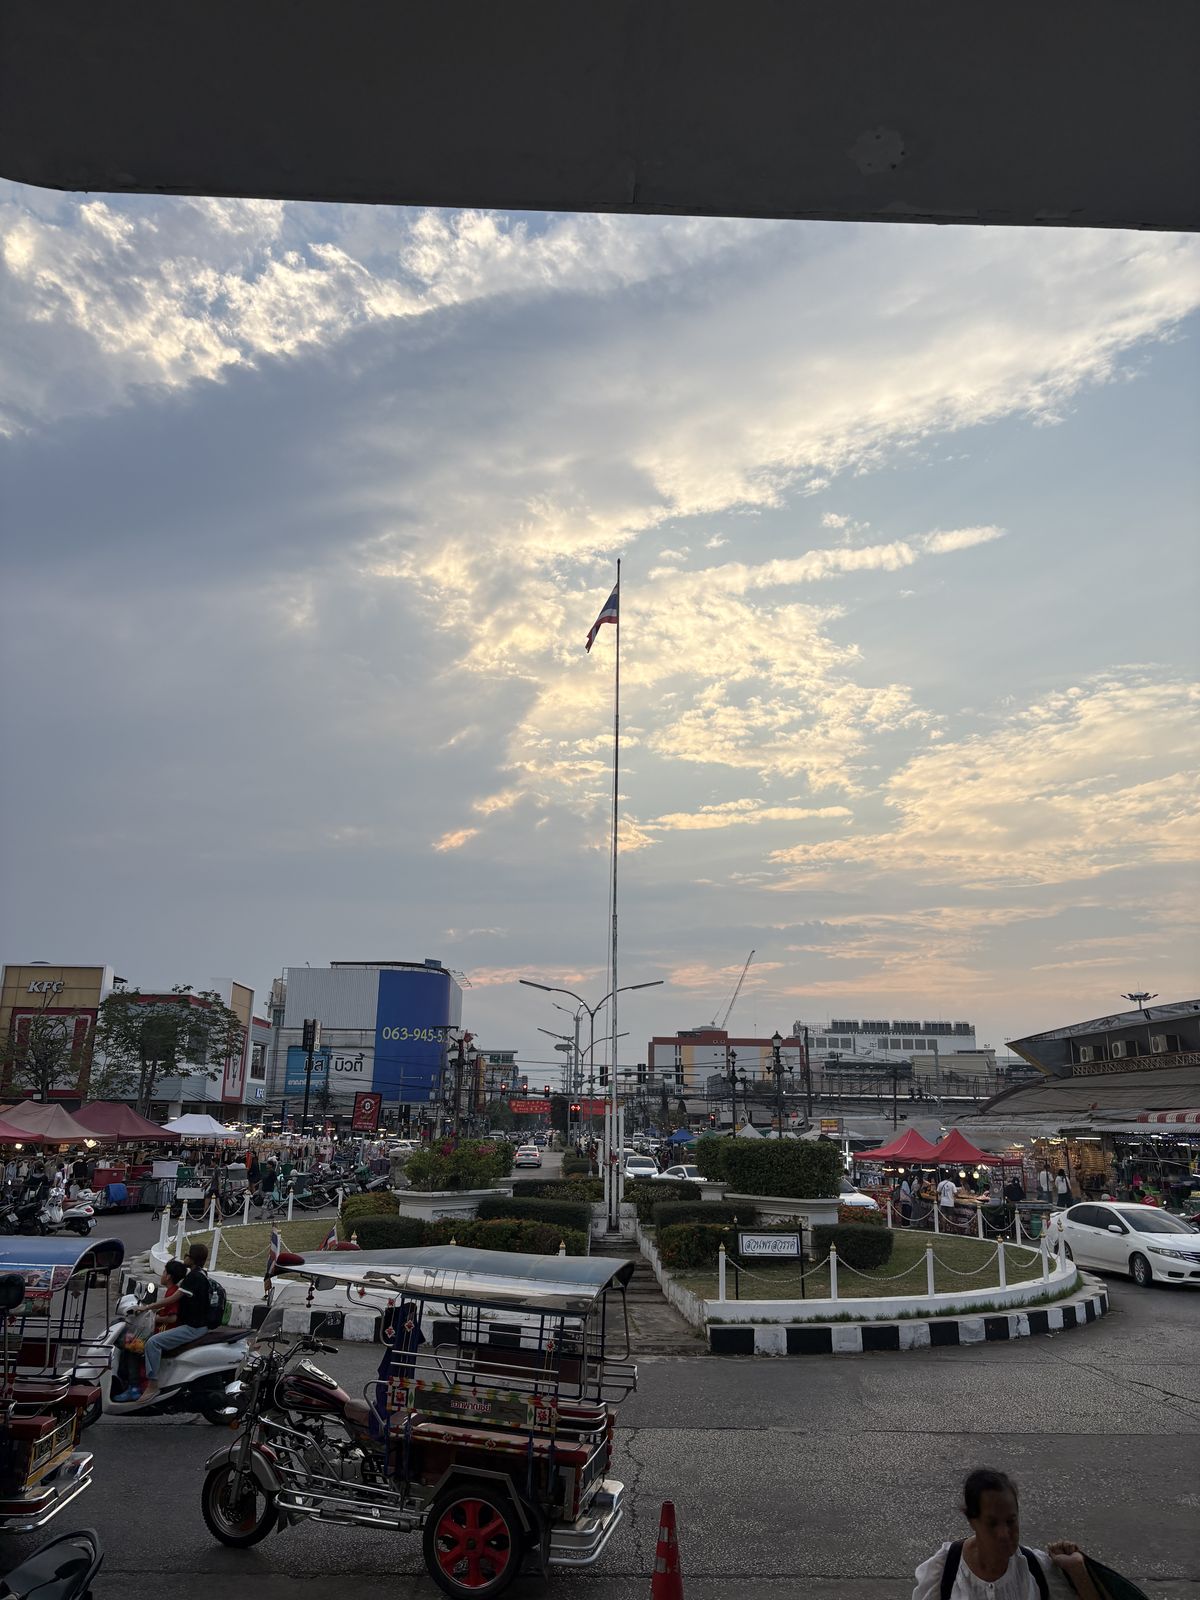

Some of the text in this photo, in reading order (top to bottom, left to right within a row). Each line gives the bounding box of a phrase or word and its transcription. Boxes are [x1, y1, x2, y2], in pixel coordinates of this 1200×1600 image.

[27, 981, 65, 994] KFC
[382, 1026, 448, 1044] 063-945-5
[334, 1053, 365, 1072] บิวตี้
